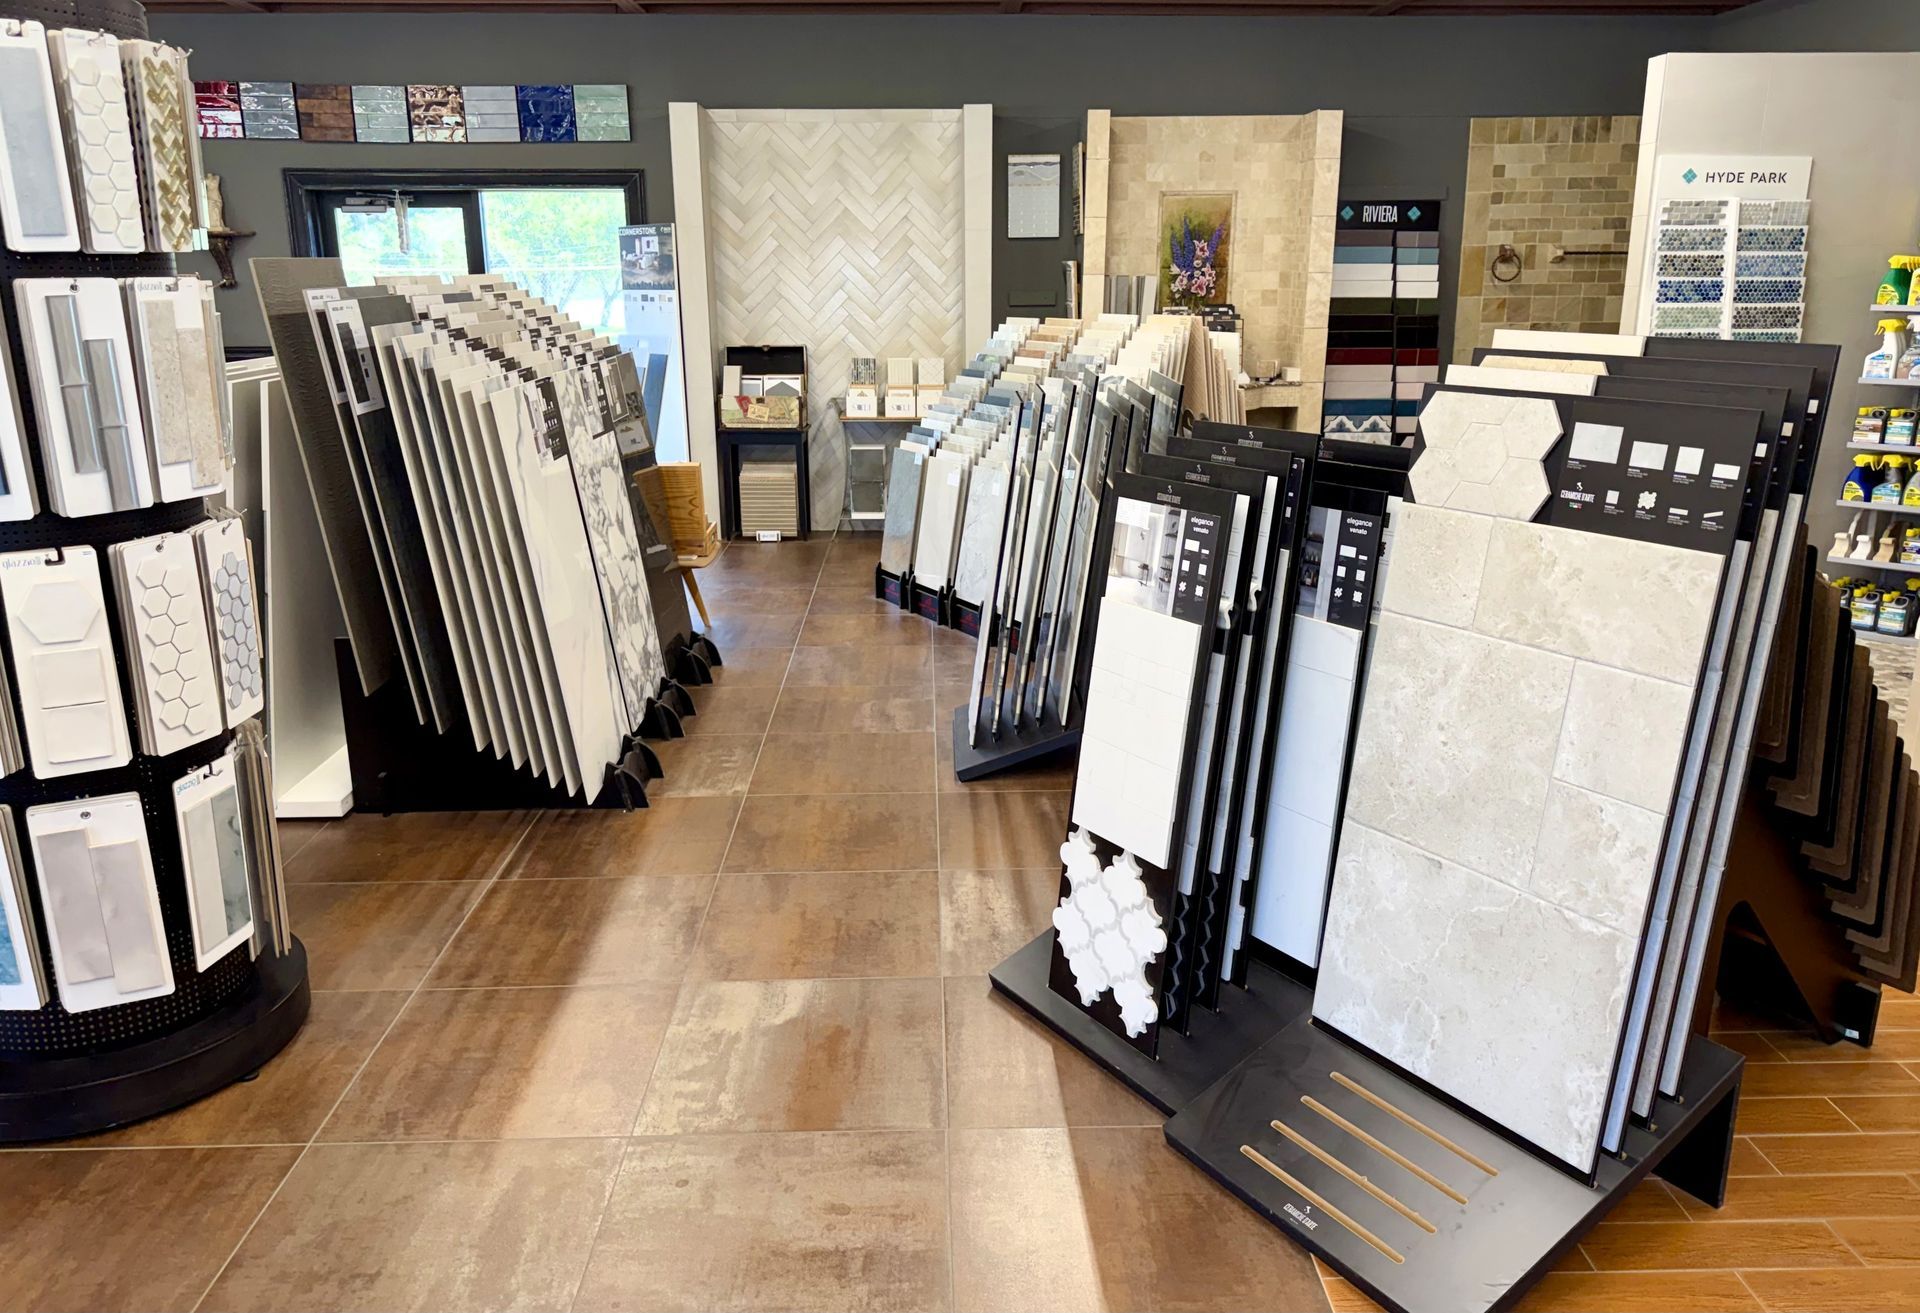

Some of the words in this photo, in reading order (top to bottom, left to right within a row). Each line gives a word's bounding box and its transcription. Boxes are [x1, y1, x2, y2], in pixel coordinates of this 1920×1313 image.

[1705, 171, 1745, 184] HYDE
[1750, 171, 1788, 184] PARK
[1362, 205, 1398, 223] RIVIERA
[619, 226, 657, 236] CORNERSTONE
[1190, 516, 1214, 527] elegance
[1346, 517, 1373, 528] elegance
[1349, 527, 1368, 536] venato
